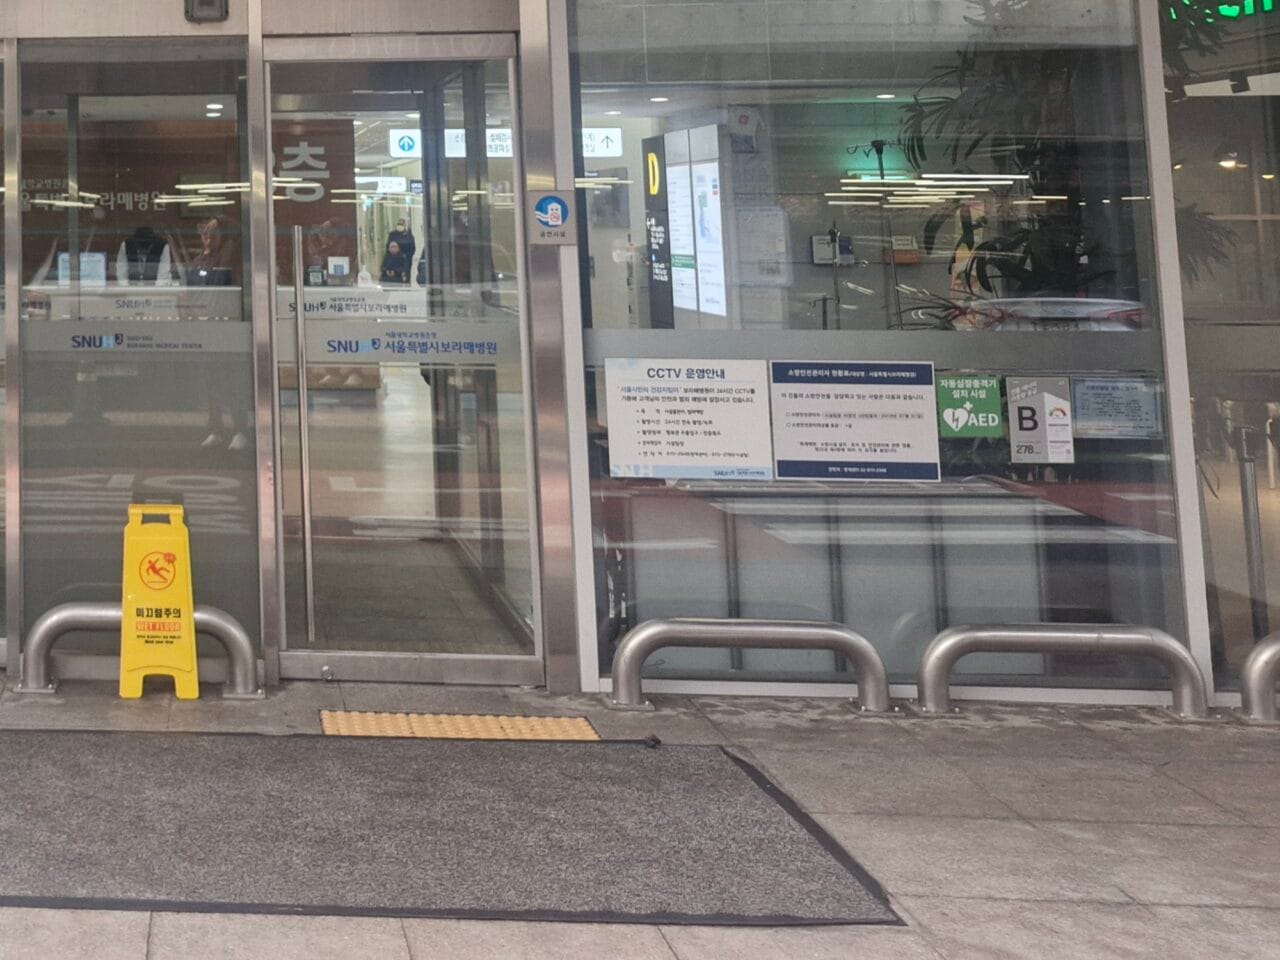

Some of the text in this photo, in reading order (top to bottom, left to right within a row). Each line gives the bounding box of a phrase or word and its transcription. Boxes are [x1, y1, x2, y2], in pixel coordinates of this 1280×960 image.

[271, 142, 330, 202] 층
[384, 341, 498, 355] 서울특별시보라매병원
[647, 368, 726, 379] CCTV 운영안내
[952, 389, 987, 399] 설치 시설
[968, 413, 999, 427] AED
[1017, 406, 1039, 431] B
[1016, 444, 1034, 454] 278
[136, 607, 181, 619] 미끄럼주의
